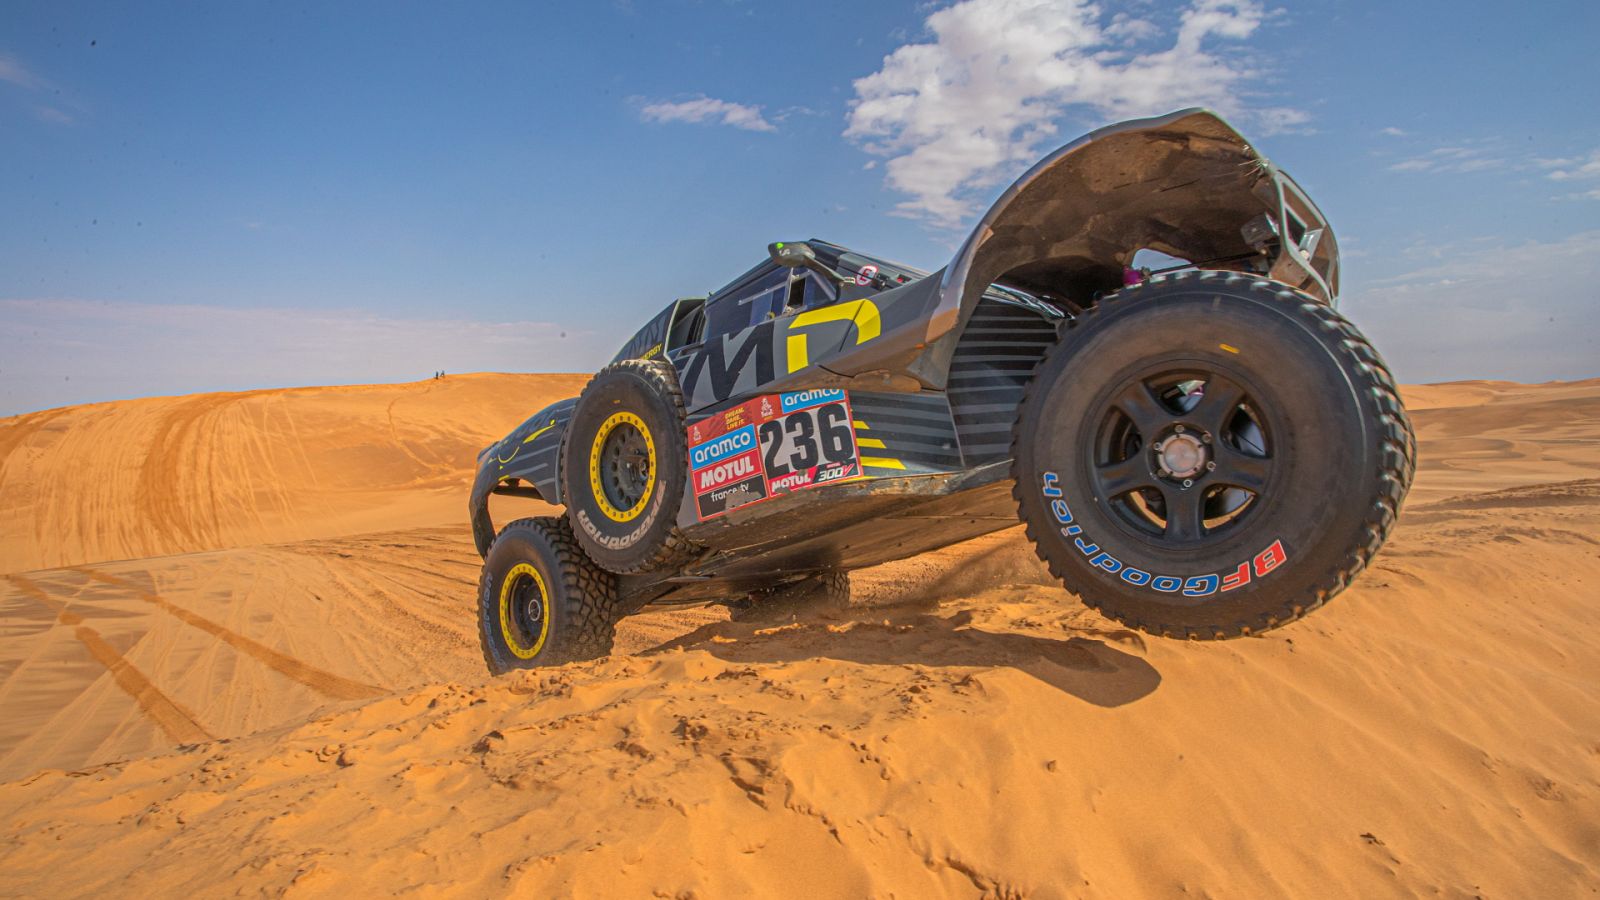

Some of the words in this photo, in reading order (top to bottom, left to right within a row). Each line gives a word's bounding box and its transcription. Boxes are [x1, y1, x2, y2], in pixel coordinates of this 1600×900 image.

[784, 388, 840, 406] aramco
[694, 431, 751, 463] aramco
[759, 402, 856, 478] 236
[700, 456, 755, 489] MOTUL
[771, 472, 811, 493] MOTUL
[817, 463, 856, 482] 300V
[1042, 471, 1287, 597] BFGoodrich
